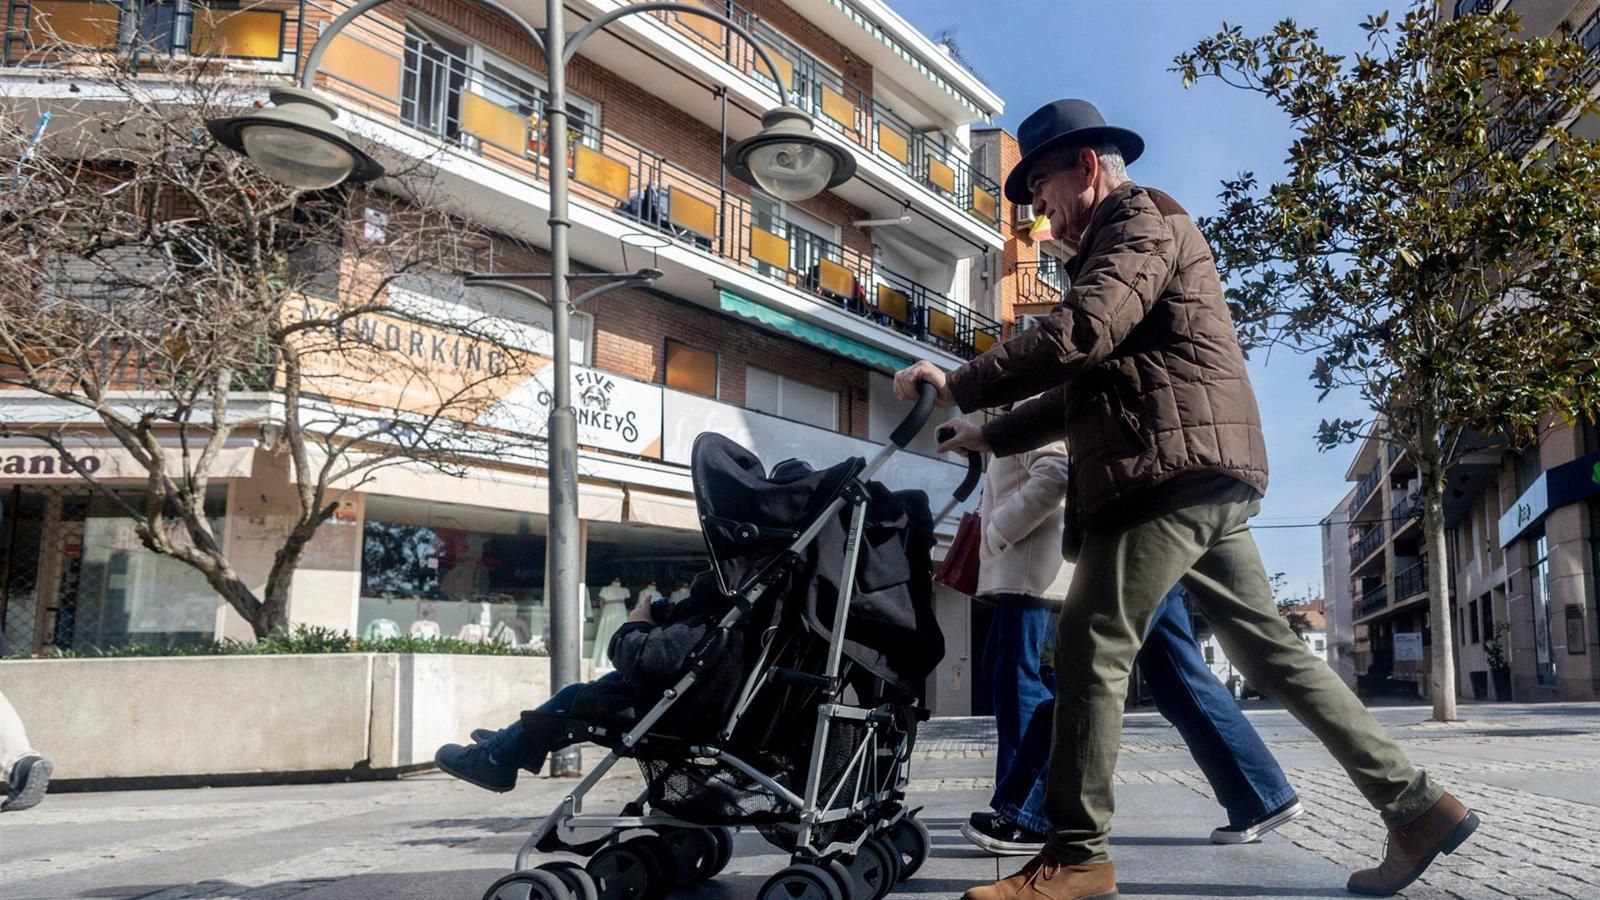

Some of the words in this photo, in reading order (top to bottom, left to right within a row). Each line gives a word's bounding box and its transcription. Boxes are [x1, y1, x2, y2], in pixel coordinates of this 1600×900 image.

[575, 372, 615, 393] FIVE
[0, 454, 101, 475] anto
[847, 527, 858, 552] PULSE
